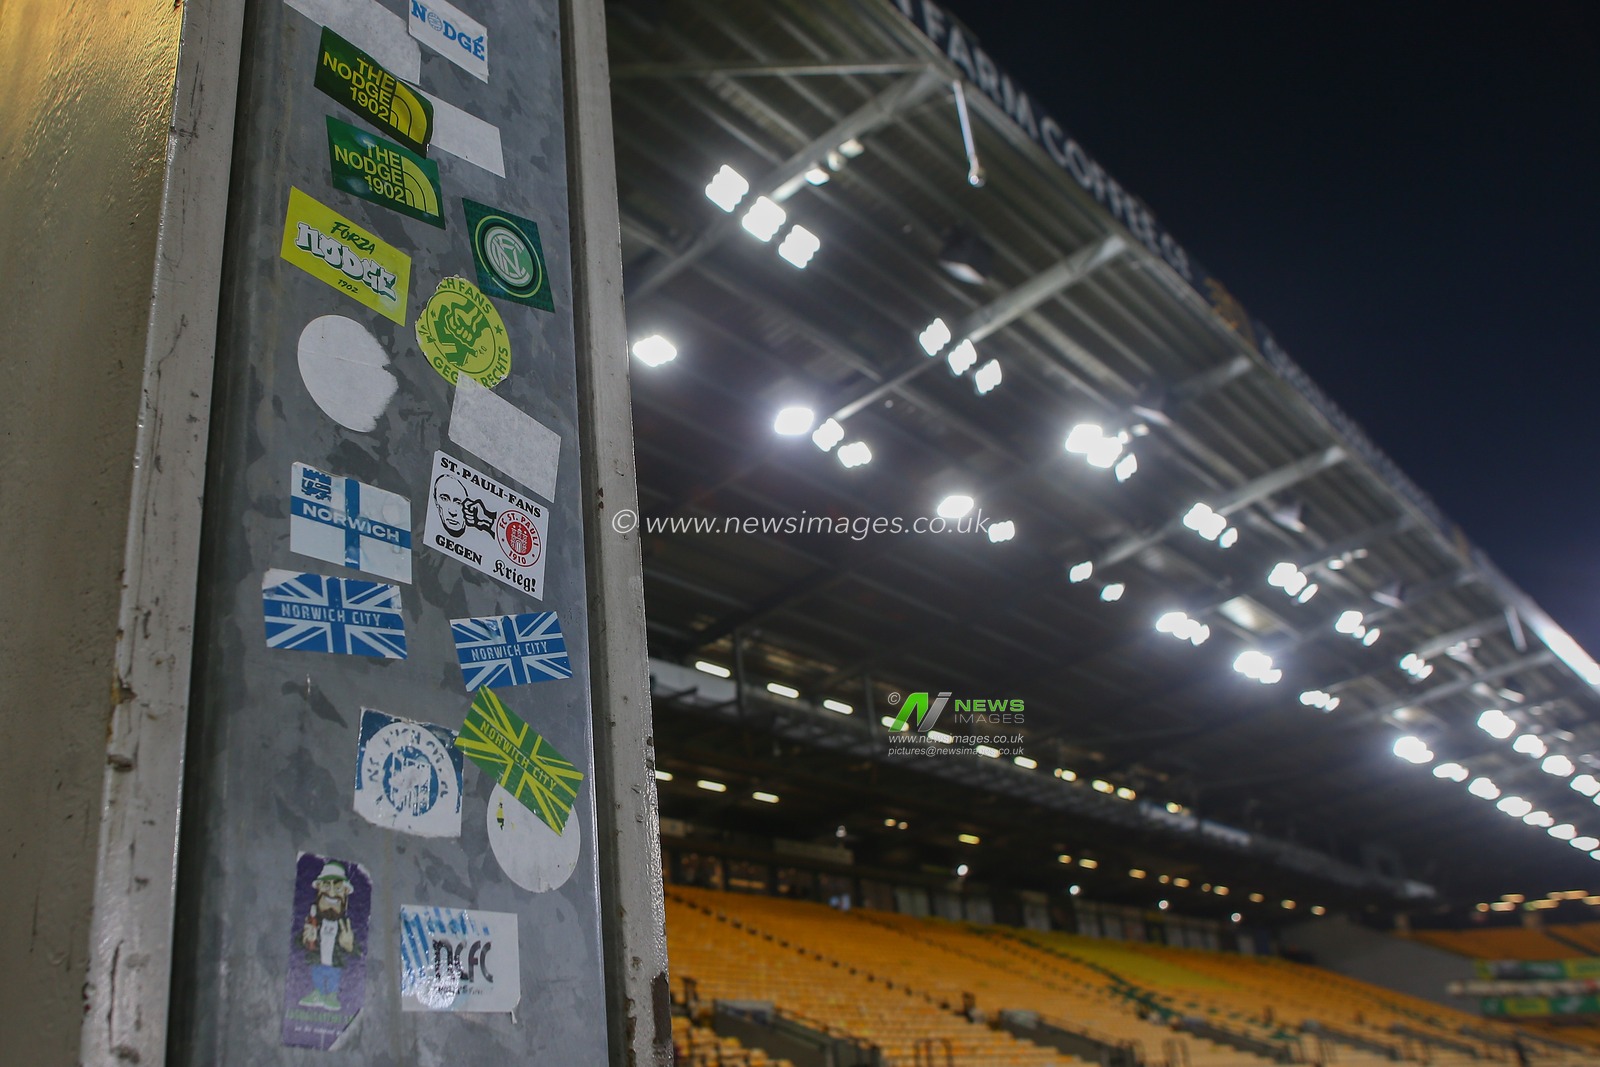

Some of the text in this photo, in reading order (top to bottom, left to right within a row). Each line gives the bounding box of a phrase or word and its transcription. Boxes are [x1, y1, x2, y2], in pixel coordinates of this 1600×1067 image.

[322, 51, 393, 109] NODGE
[355, 57, 397, 93] THE
[349, 86, 392, 124] 1902
[333, 144, 404, 185] NODGE
[366, 142, 402, 169] THE
[363, 174, 407, 204] 1902
[330, 221, 376, 255] FORZA
[337, 279, 359, 294] 1902
[458, 281, 492, 315] FANS
[302, 502, 400, 543] NORWICH
[499, 512, 539, 547] FC ST. PAULI
[435, 534, 483, 566] GEGEN
[508, 551, 527, 565] 1910
[492, 559, 537, 593] Krieg!
[281, 602, 381, 627] NORWICH CITY
[470, 641, 549, 661] NORWICH CITY
[480, 720, 530, 769] NORWICH
[532, 766, 557, 792] CITY
